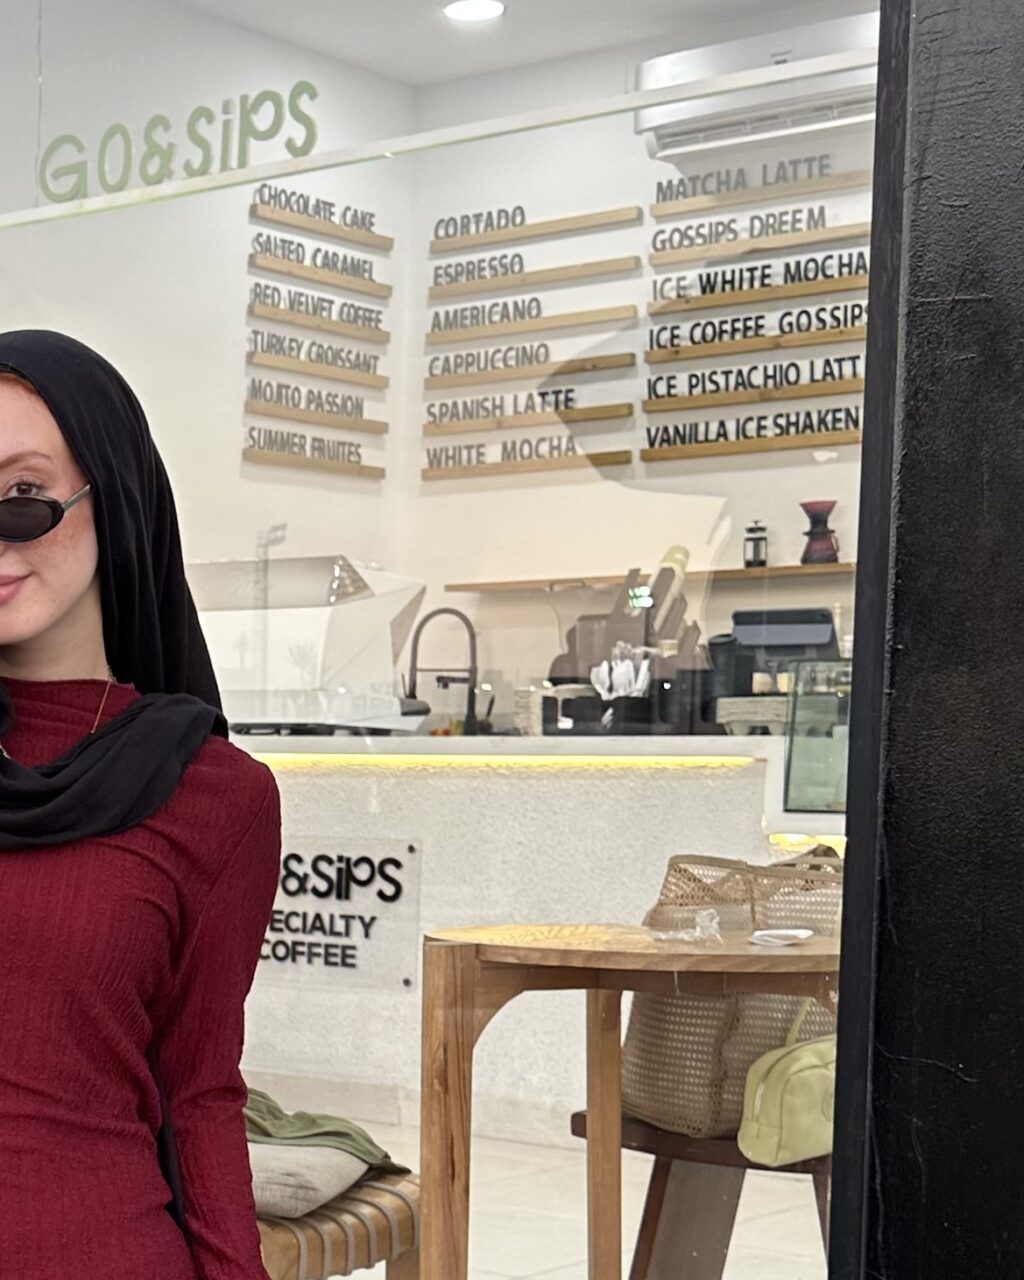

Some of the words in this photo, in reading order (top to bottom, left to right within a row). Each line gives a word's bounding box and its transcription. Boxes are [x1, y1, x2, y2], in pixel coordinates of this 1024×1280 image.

[656, 167, 747, 204] MATCHA
[761, 153, 831, 187] LATTE
[258, 183, 335, 224] CHOCOLATE
[342, 205, 376, 234] CAKE
[434, 205, 526, 241] CORTADO
[652, 218, 739, 253] GOSSIPS
[749, 205, 826, 240] DREEM
[254, 232, 305, 265] SALTED
[311, 247, 376, 283] CARAMEL
[433, 253, 524, 287] ESPRESSO
[652, 276, 688, 302] ICE
[697, 264, 772, 296] WHITE
[782, 251, 868, 285] MOCHA
[252, 282, 281, 308] RED
[287, 289, 335, 321] VELVET
[338, 302, 383, 331] COFFEE
[430, 297, 542, 334] AMERICANO
[649, 325, 681, 351] ICE
[689, 315, 766, 346] COFFEE
[778, 302, 868, 335] GOSSIP
[251, 330, 304, 359] TURKEY
[306, 341, 380, 375] CROISSANT
[428, 343, 550, 378] CAPPUCCINO
[250, 378, 303, 409] MOJITO
[305, 389, 365, 419] PASSION
[647, 376, 678, 401] ICE
[687, 361, 801, 397] PISTACHIO
[809, 355, 861, 384] LATT
[426, 395, 505, 425] SPANISH
[513, 388, 575, 416] LATTE
[646, 419, 729, 449] VANILLA
[735, 416, 768, 441] ICE
[772, 406, 860, 438] SHAKEN
[248, 426, 308, 458] SUMMER
[309, 436, 362, 465] FRUITES
[426, 443, 487, 469] WHITE
[501, 435, 576, 463] MOCHA
[281, 852, 404, 904] &SiPS
[269, 909, 378, 940] ECIALTY
